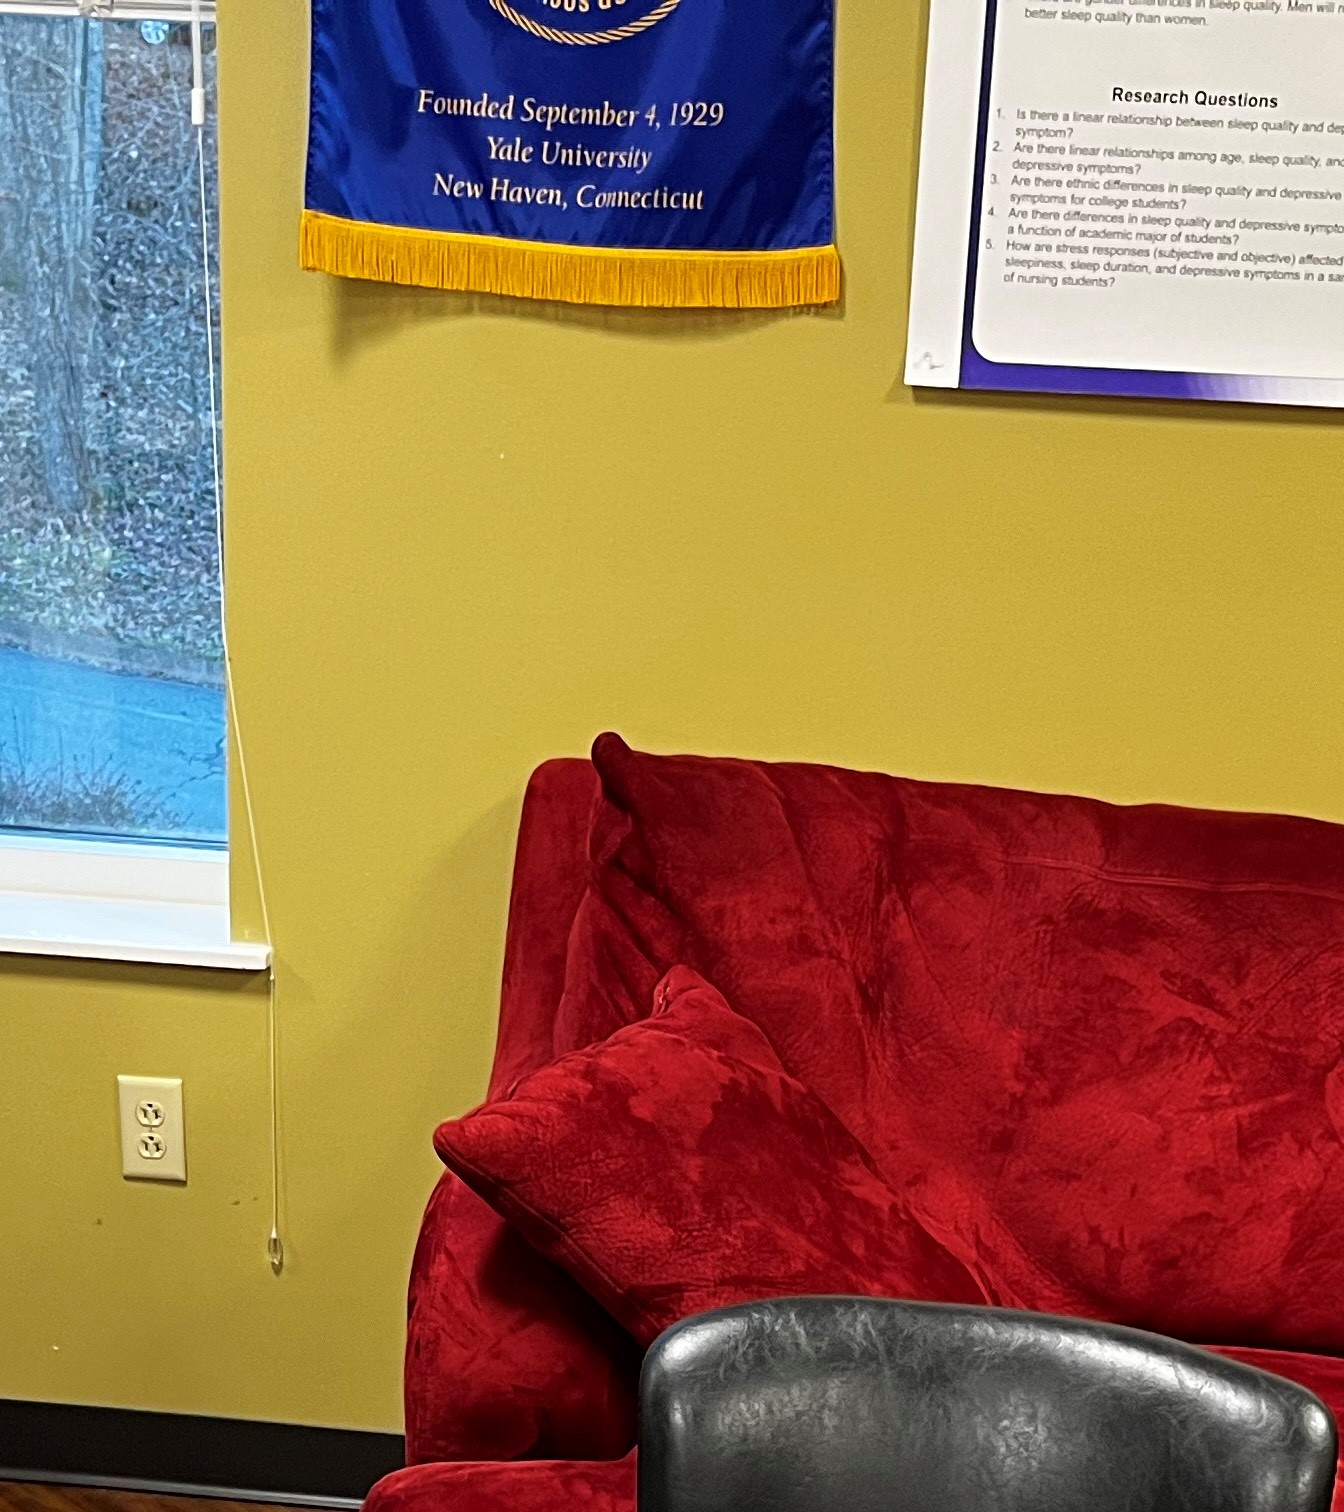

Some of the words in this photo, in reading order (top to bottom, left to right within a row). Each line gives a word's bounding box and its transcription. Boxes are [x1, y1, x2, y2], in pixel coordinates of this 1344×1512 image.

[416, 88, 515, 121] Founded
[519, 96, 640, 132] September
[643, 103, 661, 130] 4,
[669, 100, 724, 127] 1929
[1111, 85, 1189, 105] Research
[1193, 89, 1279, 109] Questions
[486, 134, 534, 164] Yale
[541, 140, 652, 175] University
[432, 172, 484, 199] New
[489, 176, 568, 211] Haven,
[575, 183, 703, 210] Connecticut
